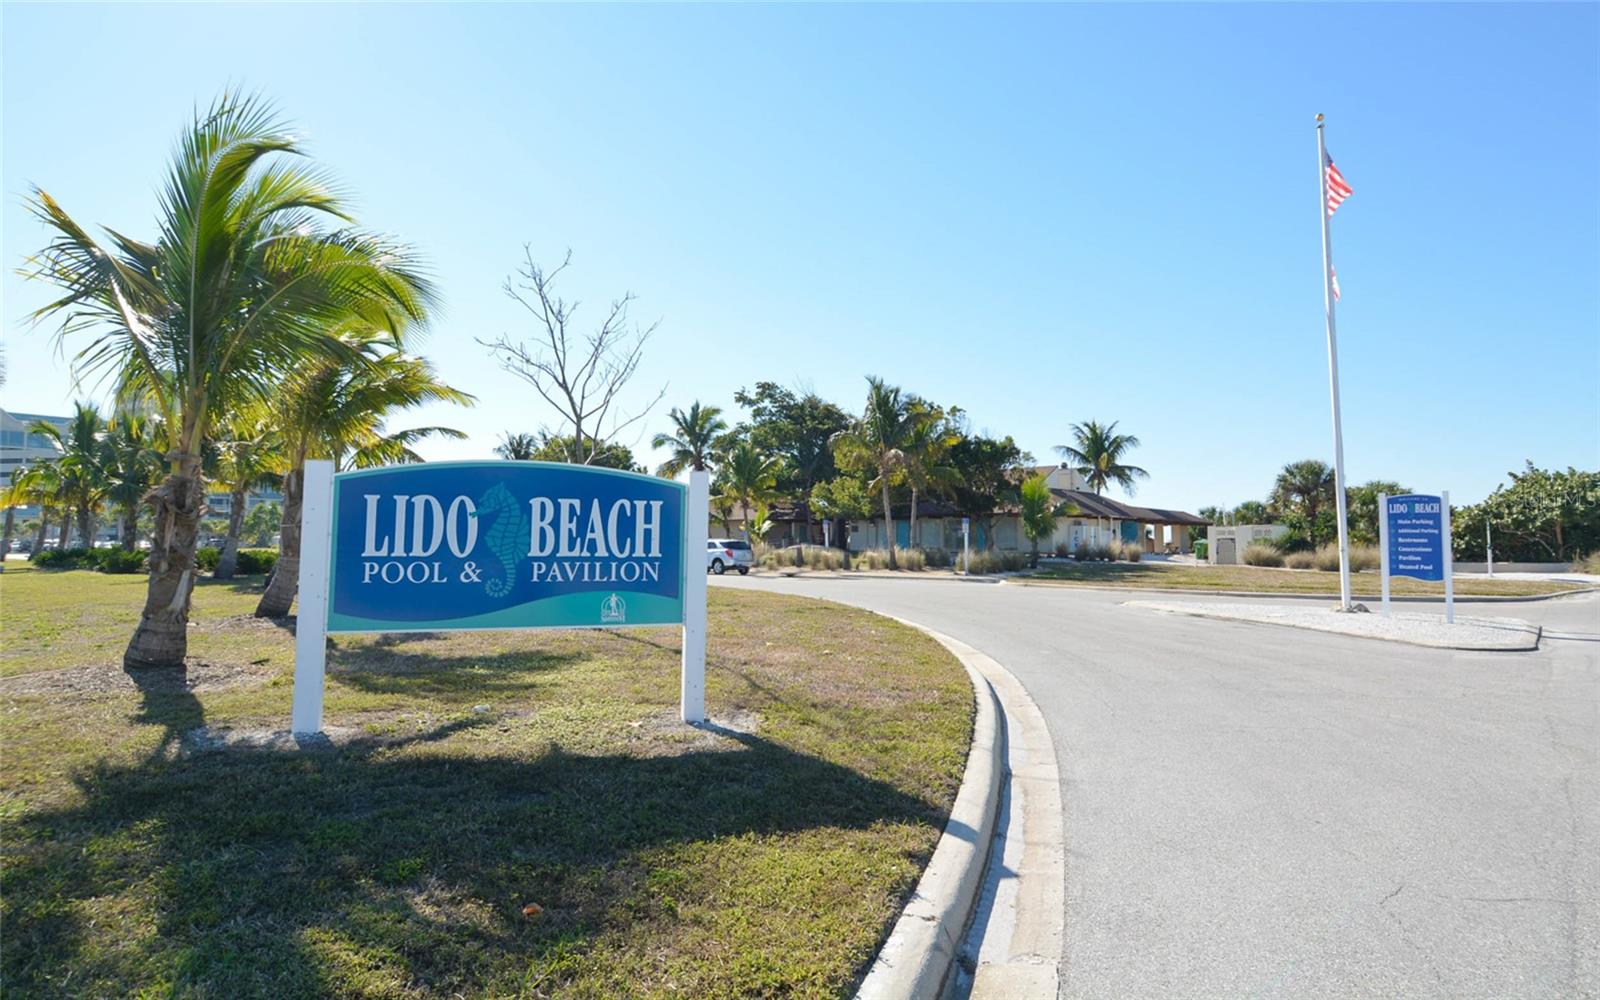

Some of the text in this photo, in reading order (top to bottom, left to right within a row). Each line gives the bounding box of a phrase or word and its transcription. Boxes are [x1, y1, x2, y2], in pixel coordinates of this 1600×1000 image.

[1389, 503, 1440, 513] LIDO BEACH
[361, 494, 664, 559] LIDO BEACH
[361, 561, 661, 584] POOL & PAVILION
